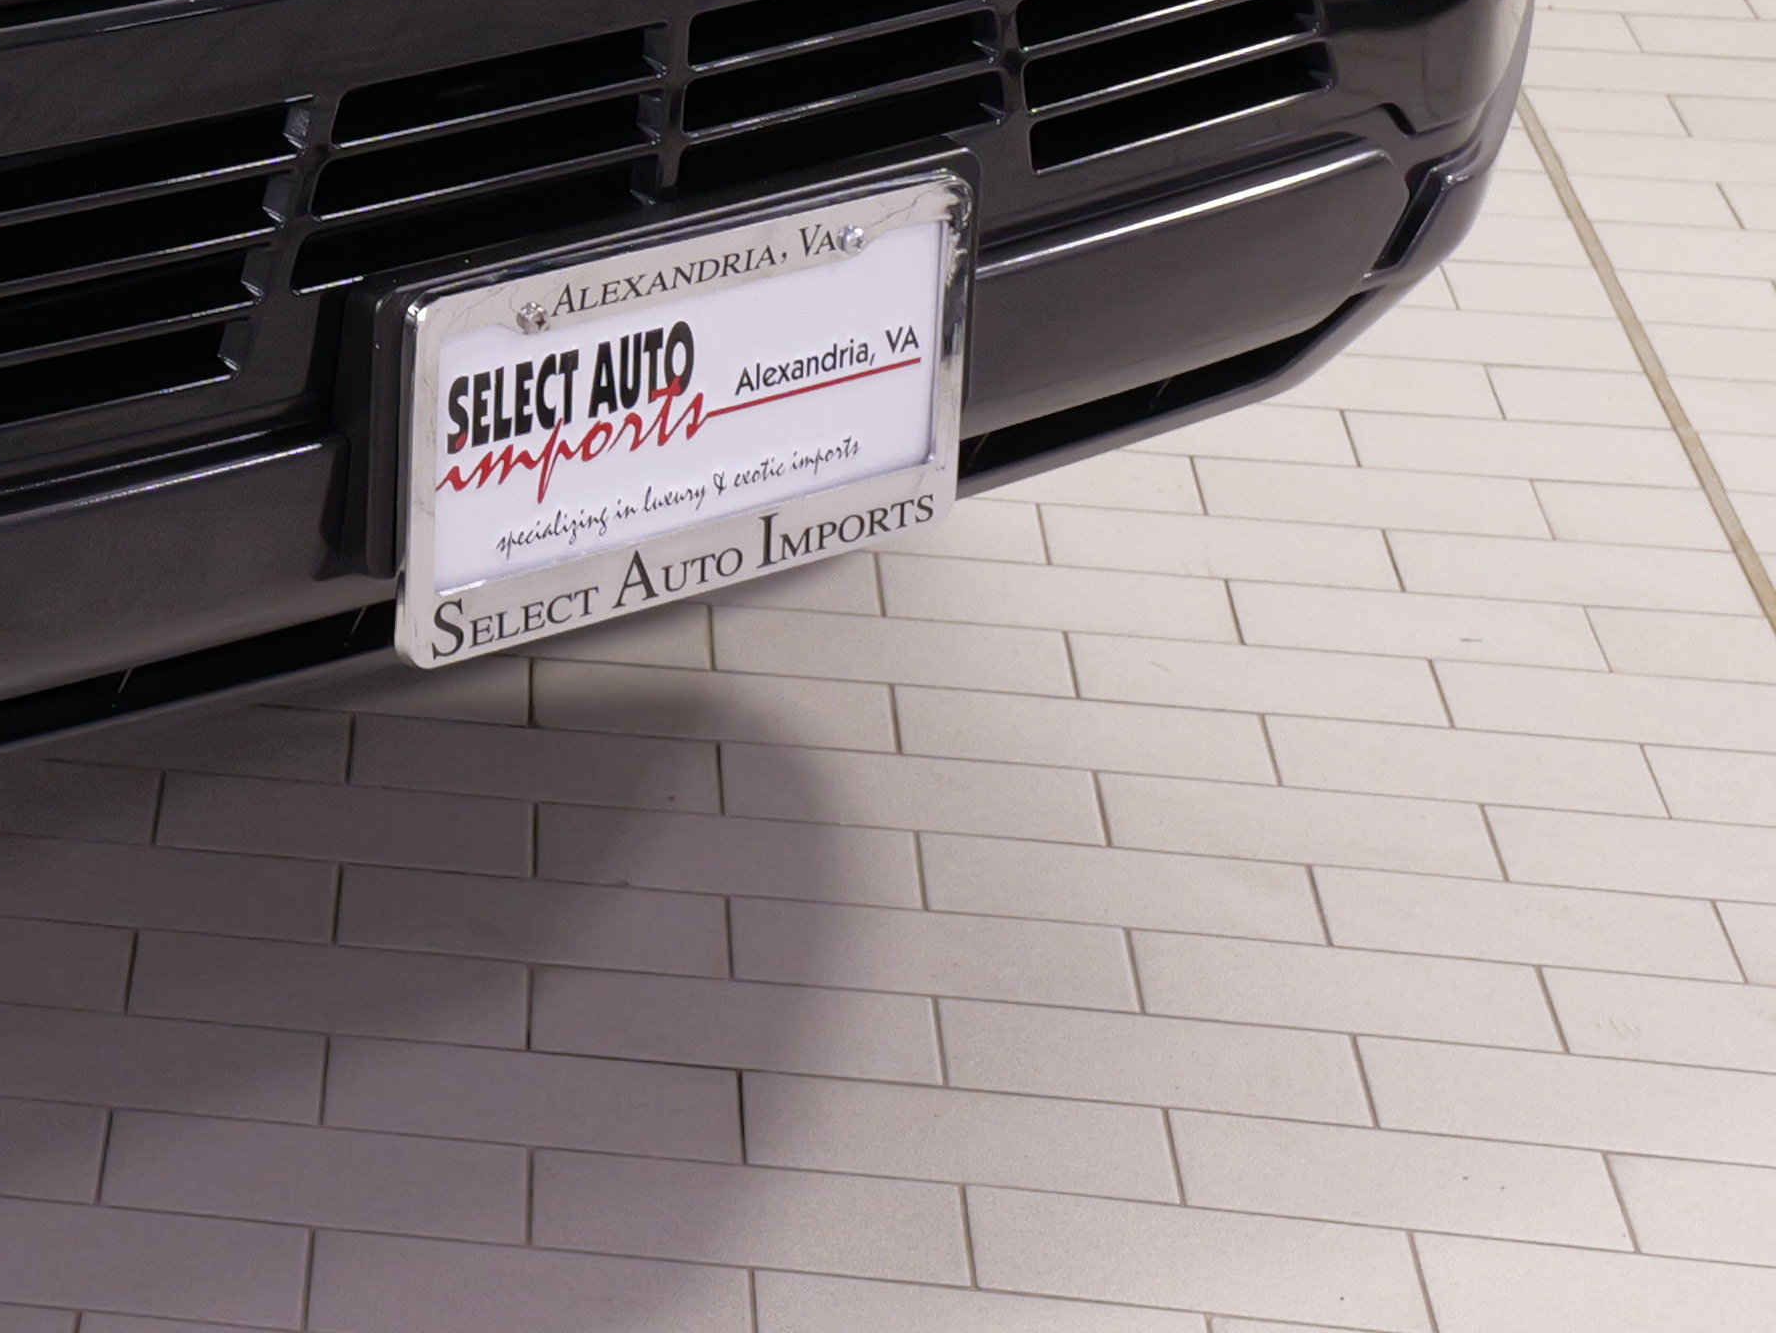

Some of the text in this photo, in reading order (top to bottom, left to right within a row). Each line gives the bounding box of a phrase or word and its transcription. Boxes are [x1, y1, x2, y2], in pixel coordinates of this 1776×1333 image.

[550, 244, 788, 317] ALEXANDRIA,
[447, 320, 695, 455] SELECT AUTO
[734, 324, 920, 397] Alexandria, VA
[435, 374, 706, 505] imports
[496, 506, 609, 560] specializing
[614, 499, 638, 521] in
[643, 485, 706, 511] luxury
[733, 457, 785, 488] exotic
[792, 435, 861, 475] imports
[430, 493, 936, 661] SELECT AUTO IMPORTS
